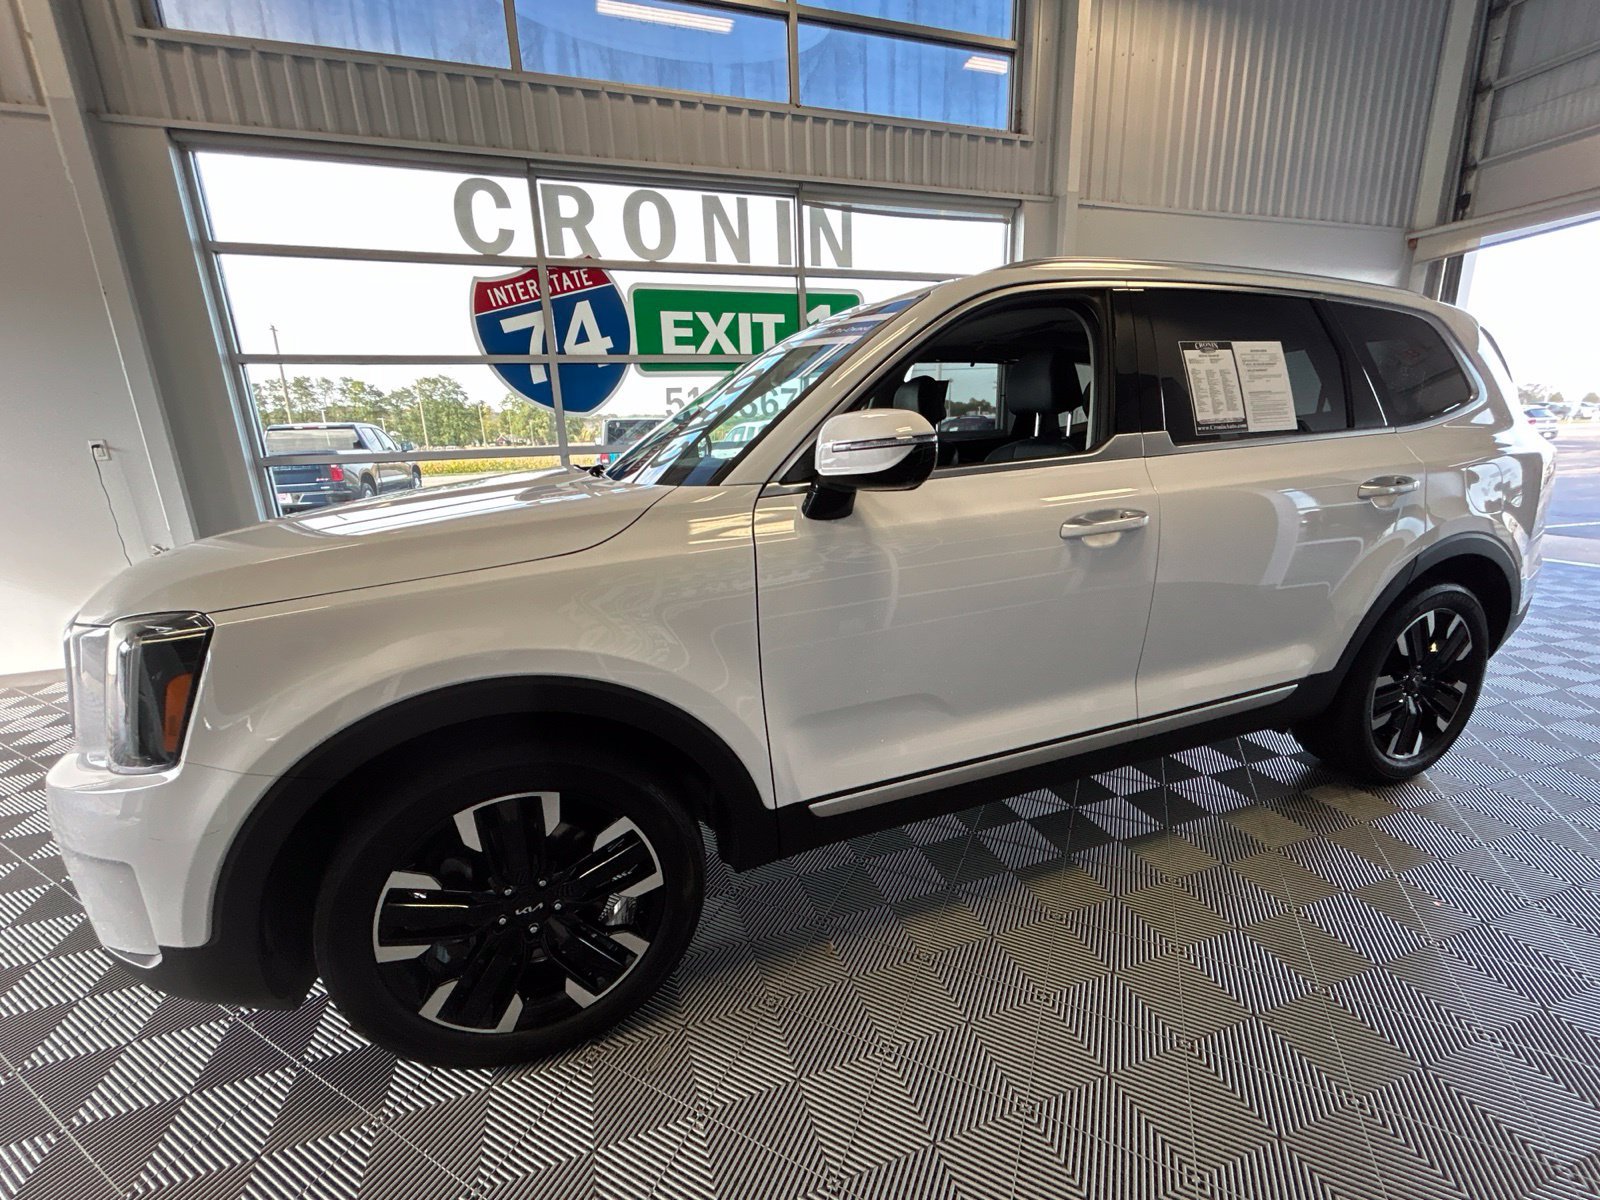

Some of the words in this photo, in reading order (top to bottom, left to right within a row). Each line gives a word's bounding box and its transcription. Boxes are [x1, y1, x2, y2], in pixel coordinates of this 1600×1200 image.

[454, 177, 853, 268] CRONIN
[487, 268, 593, 307] INTERTATE
[500, 300, 613, 384] 74
[660, 310, 785, 355] EXIT
